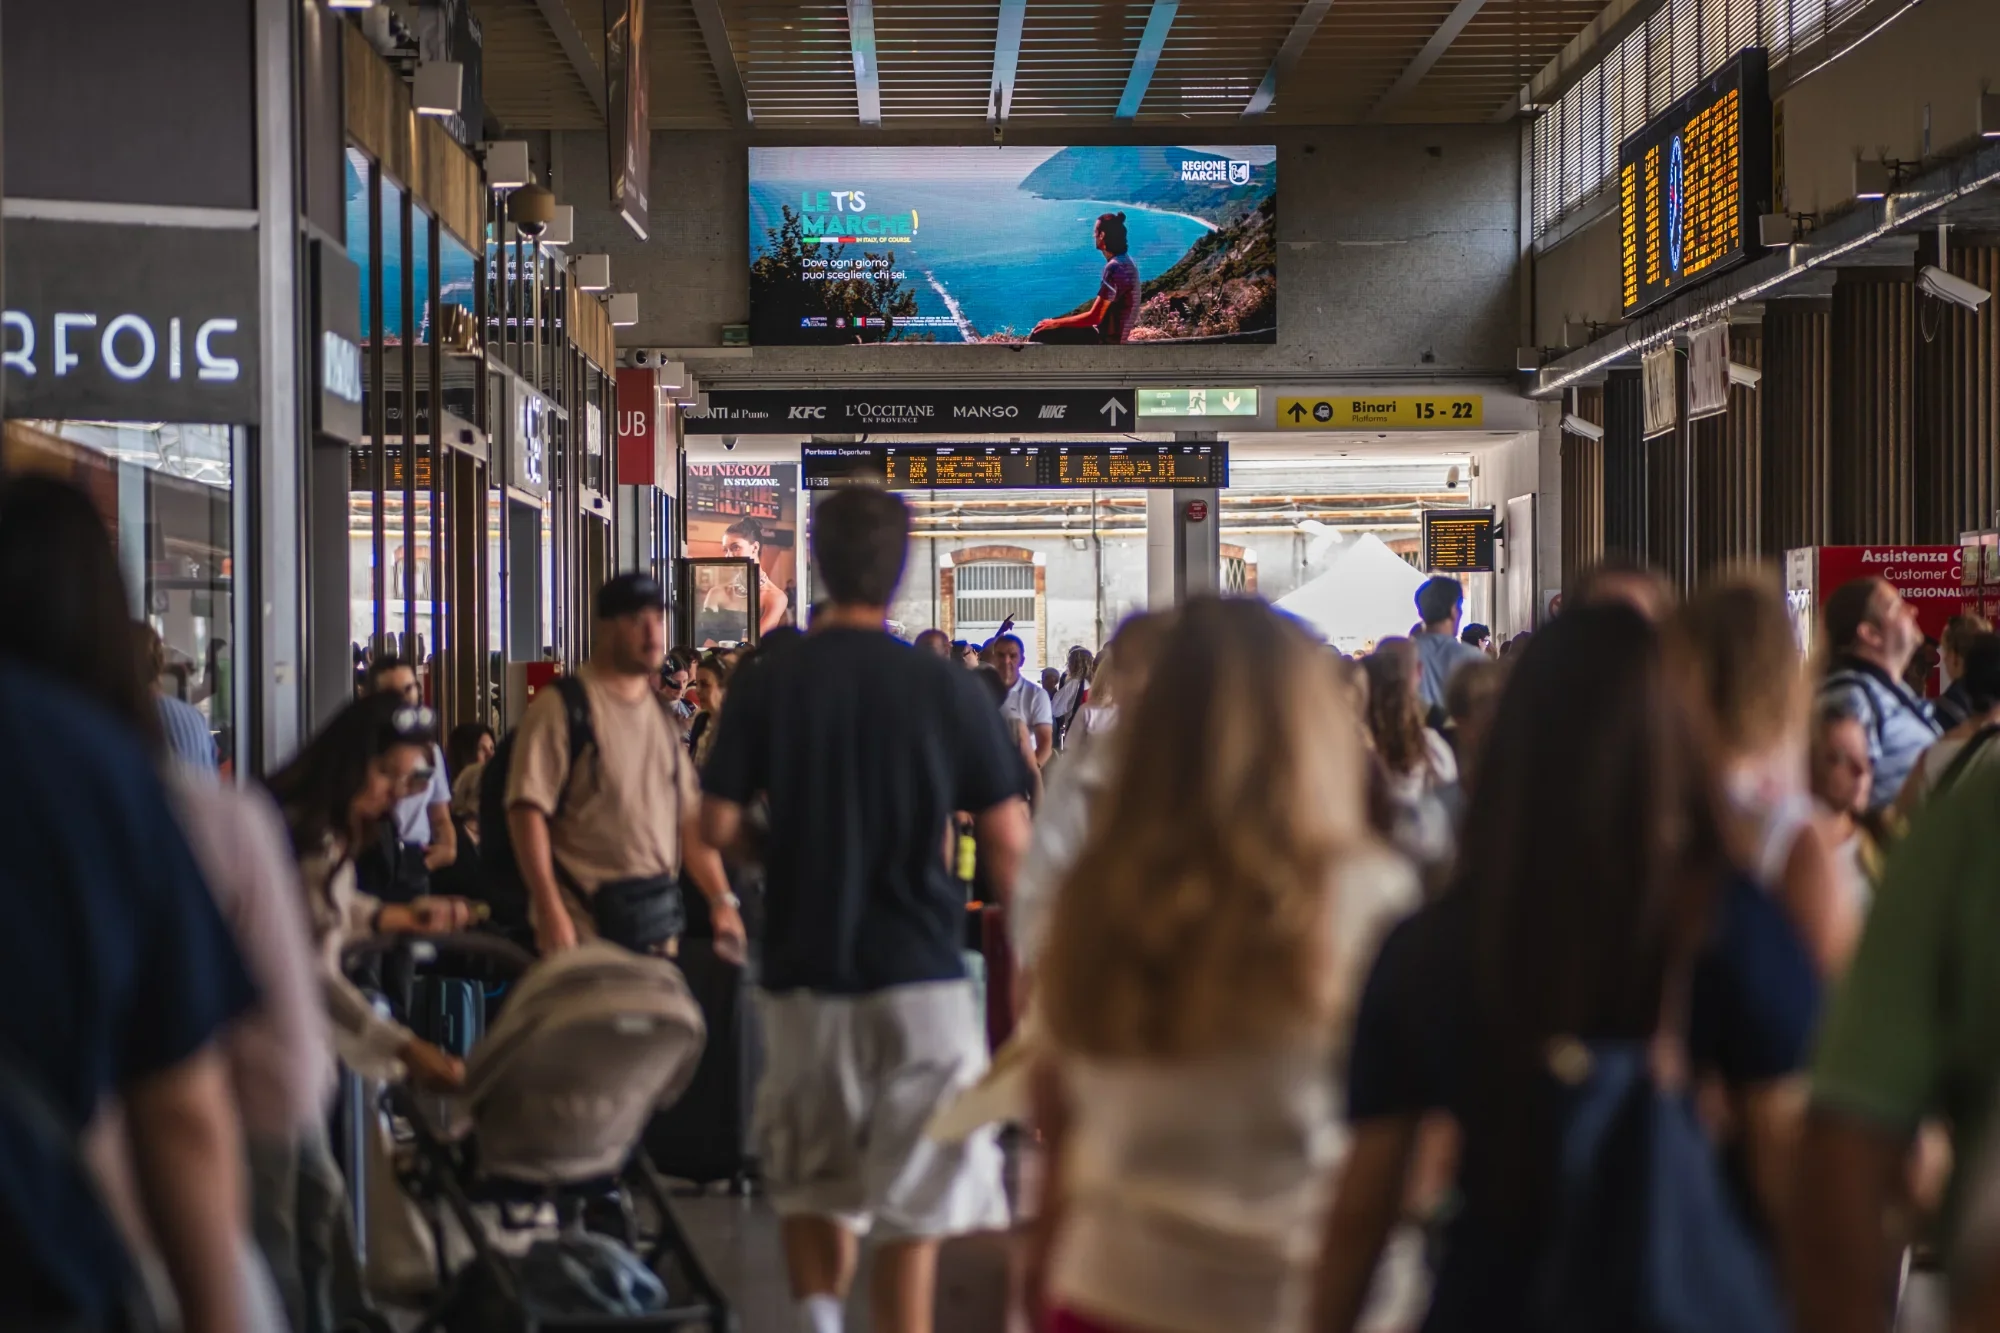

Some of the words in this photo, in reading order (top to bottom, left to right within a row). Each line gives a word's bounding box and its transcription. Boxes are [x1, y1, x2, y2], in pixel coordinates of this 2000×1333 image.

[1182, 160, 1227, 170] REGIONE
[1181, 171, 1227, 181] MARCHE
[802, 190, 866, 212] LET'S
[802, 209, 919, 235] MARCHE!
[802, 258, 829, 268] Dove
[830, 258, 854, 271] ogni
[855, 258, 889, 271] giorno
[802, 270, 825, 281] puoi
[826, 270, 872, 281] scegliere
[873, 270, 889, 279] chi
[891, 270, 908, 279] sei.
[684, 407, 728, 419] NTI
[731, 409, 740, 419] al
[742, 409, 769, 419] Punto
[787, 406, 827, 419] KFC
[953, 405, 1019, 418] MANGO
[1038, 405, 1067, 419] NIKE
[1352, 400, 1397, 413] Binari
[1415, 402, 1434, 419] 15
[1452, 402, 1473, 419] 22
[1352, 414, 1388, 423] Platforms
[838, 448, 871, 456] Departures
[689, 465, 713, 476] NEI
[716, 464, 771, 477] NEGOZI
[724, 478, 733, 486] IN
[734, 478, 780, 486] STAZIONE.
[1861, 549, 1948, 563] Assistenza
[1883, 567, 1948, 580] Customer
